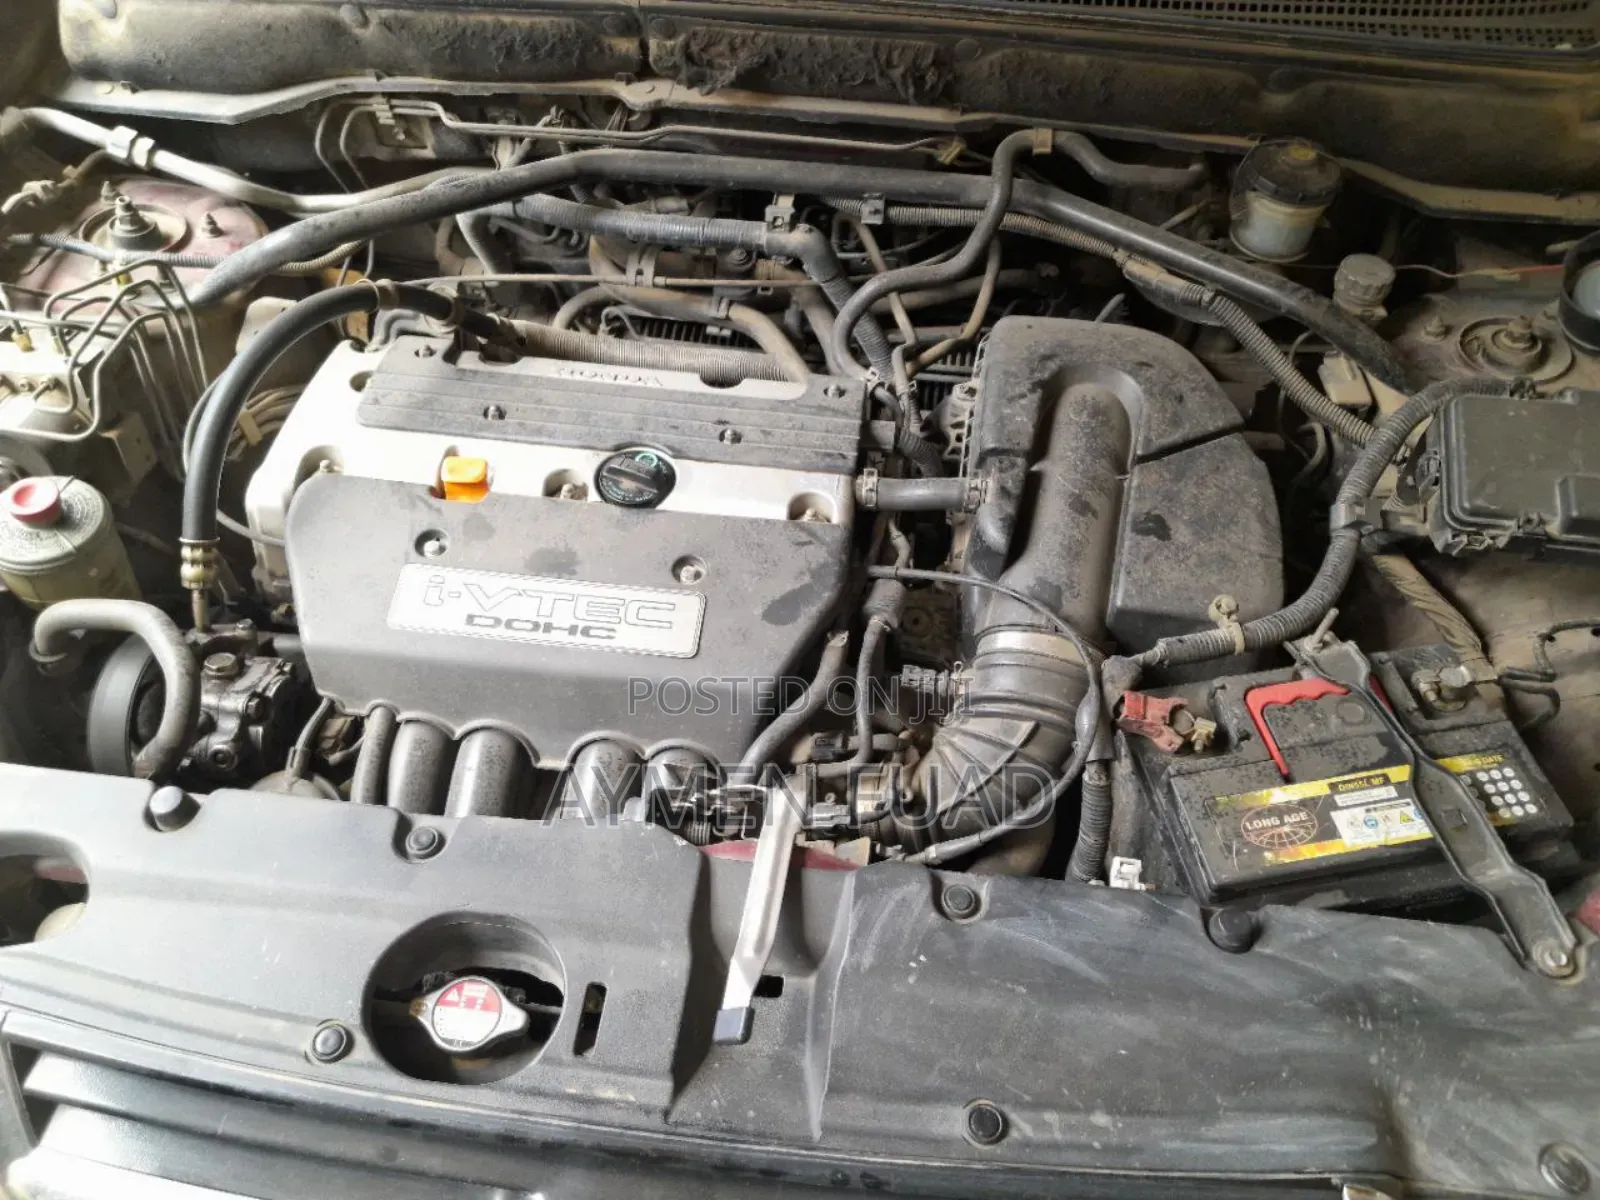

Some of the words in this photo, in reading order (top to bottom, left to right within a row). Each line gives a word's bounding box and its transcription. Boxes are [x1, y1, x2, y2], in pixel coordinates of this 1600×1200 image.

[423, 574, 676, 630] i-VTEC
[465, 613, 617, 640] DOHC
[1245, 816, 1280, 830] LONG
[1283, 811, 1309, 823] AGE
